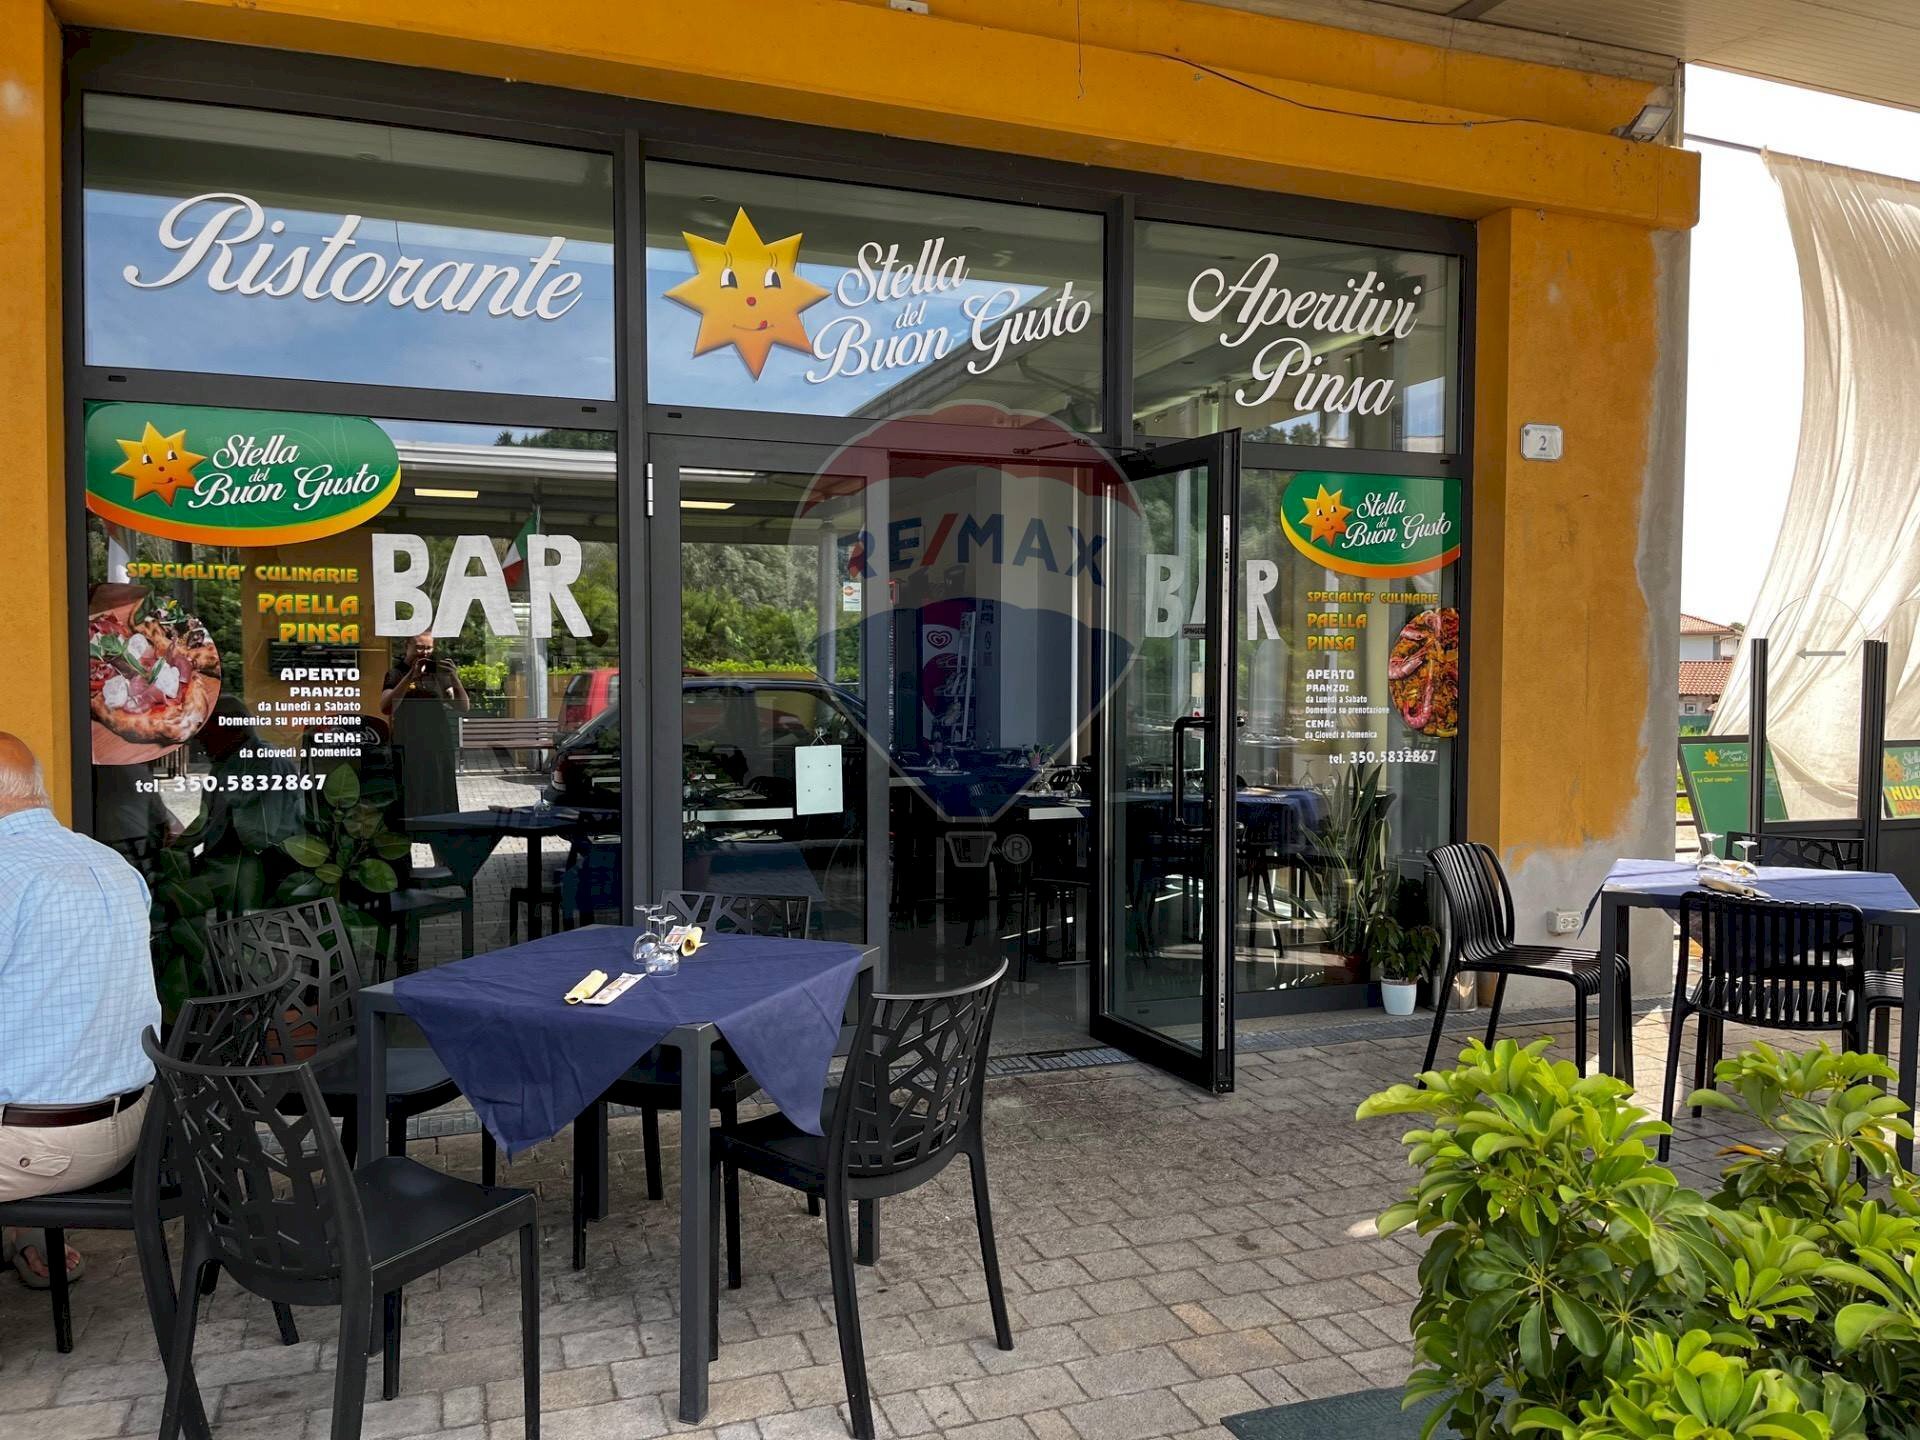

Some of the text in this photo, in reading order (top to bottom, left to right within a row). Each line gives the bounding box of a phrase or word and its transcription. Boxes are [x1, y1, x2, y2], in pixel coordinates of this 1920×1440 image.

[122, 192, 583, 320] Ristorante
[837, 236, 970, 308] Stella
[1187, 253, 1422, 347] Aperitivi
[895, 300, 926, 329] del
[805, 281, 1092, 385] Buon Gusto
[1235, 337, 1396, 415] Pinsa
[1539, 435, 1547, 451] 2
[212, 434, 300, 469] Stella
[249, 467, 270, 483] del
[187, 464, 380, 511] Buon Gusto
[1356, 491, 1407, 519] Stella
[1376, 517, 1389, 528] del
[1341, 512, 1452, 550] Buon Gusto
[126, 562, 360, 584] SPECIALITA' CULINARIE
[371, 533, 592, 638] BAR
[257, 593, 360, 616] PAELLA
[1307, 591, 1439, 606] SPECIALITA' CULINARIE
[1307, 613, 1368, 629] PAELLA
[279, 622, 360, 645] PINSA
[1307, 636, 1356, 652] PINSA
[280, 667, 360, 681] APERTO
[1306, 669, 1355, 680] APERTO
[290, 686, 360, 698] PRANZO:
[1306, 684, 1350, 693] PRANZO:
[258, 701, 361, 712] da Lunedì a Sabato
[1305, 695, 1314, 703] da
[1345, 695, 1368, 704] Sabato
[1305, 706, 1337, 714] Domenica
[1348, 706, 1390, 716] prenotazione
[218, 715, 362, 728] Domenica su prenotazione
[1305, 720, 1335, 728] CENA:
[313, 732, 362, 743] CENA:
[1304, 731, 1313, 739] da
[1347, 730, 1378, 739] Domenica
[239, 747, 362, 759] da Giovedì a Domenica
[1329, 750, 1437, 764] tel. 350.5832867
[135, 773, 327, 793] tel. 350.5832867
